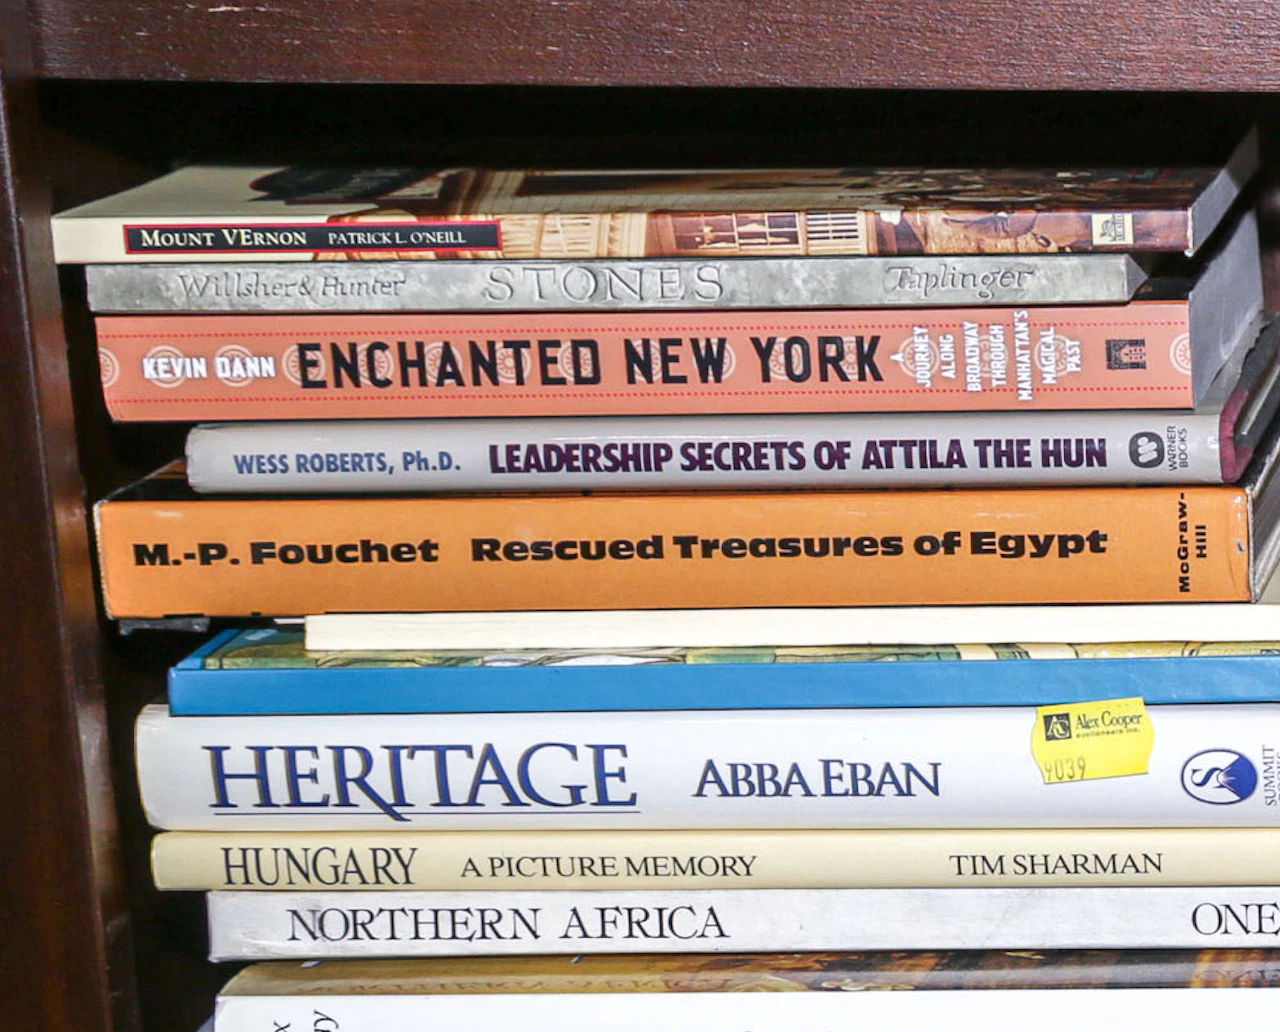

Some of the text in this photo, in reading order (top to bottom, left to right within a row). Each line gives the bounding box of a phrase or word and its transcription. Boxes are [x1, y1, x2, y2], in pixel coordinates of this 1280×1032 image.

[486, 265, 726, 302] STONES
[886, 263, 1034, 298] Taplinger
[142, 357, 276, 379] KEVIN DANN
[299, 335, 882, 389] ENCHANTED NEW YORK
[913, 326, 932, 388] JOURNEY
[939, 334, 956, 379] ALONG
[963, 321, 982, 391] BROADWAY
[989, 324, 1007, 387] THROUGH
[1067, 340, 1081, 372] PAST
[233, 450, 461, 476] WESS ROBERTS, Ph.D.
[1167, 425, 1178, 471] WARNER
[1178, 428, 1188, 468] BOOKS
[472, 530, 1107, 562] Rescued Treasures of Egypt
[1178, 493, 1190, 592] McGraw-
[1196, 525, 1207, 558] Hill
[201, 742, 639, 822] HERITAGE
[692, 759, 940, 797] ABBA EBAN
[1262, 745, 1277, 806] SUMMIT
[221, 848, 418, 886] HUNGARY
[461, 855, 758, 878] A PICTURE MEMORY
[949, 852, 1163, 876] TIM SHARMAN
[286, 906, 730, 942] NORTHERN AFRICA
